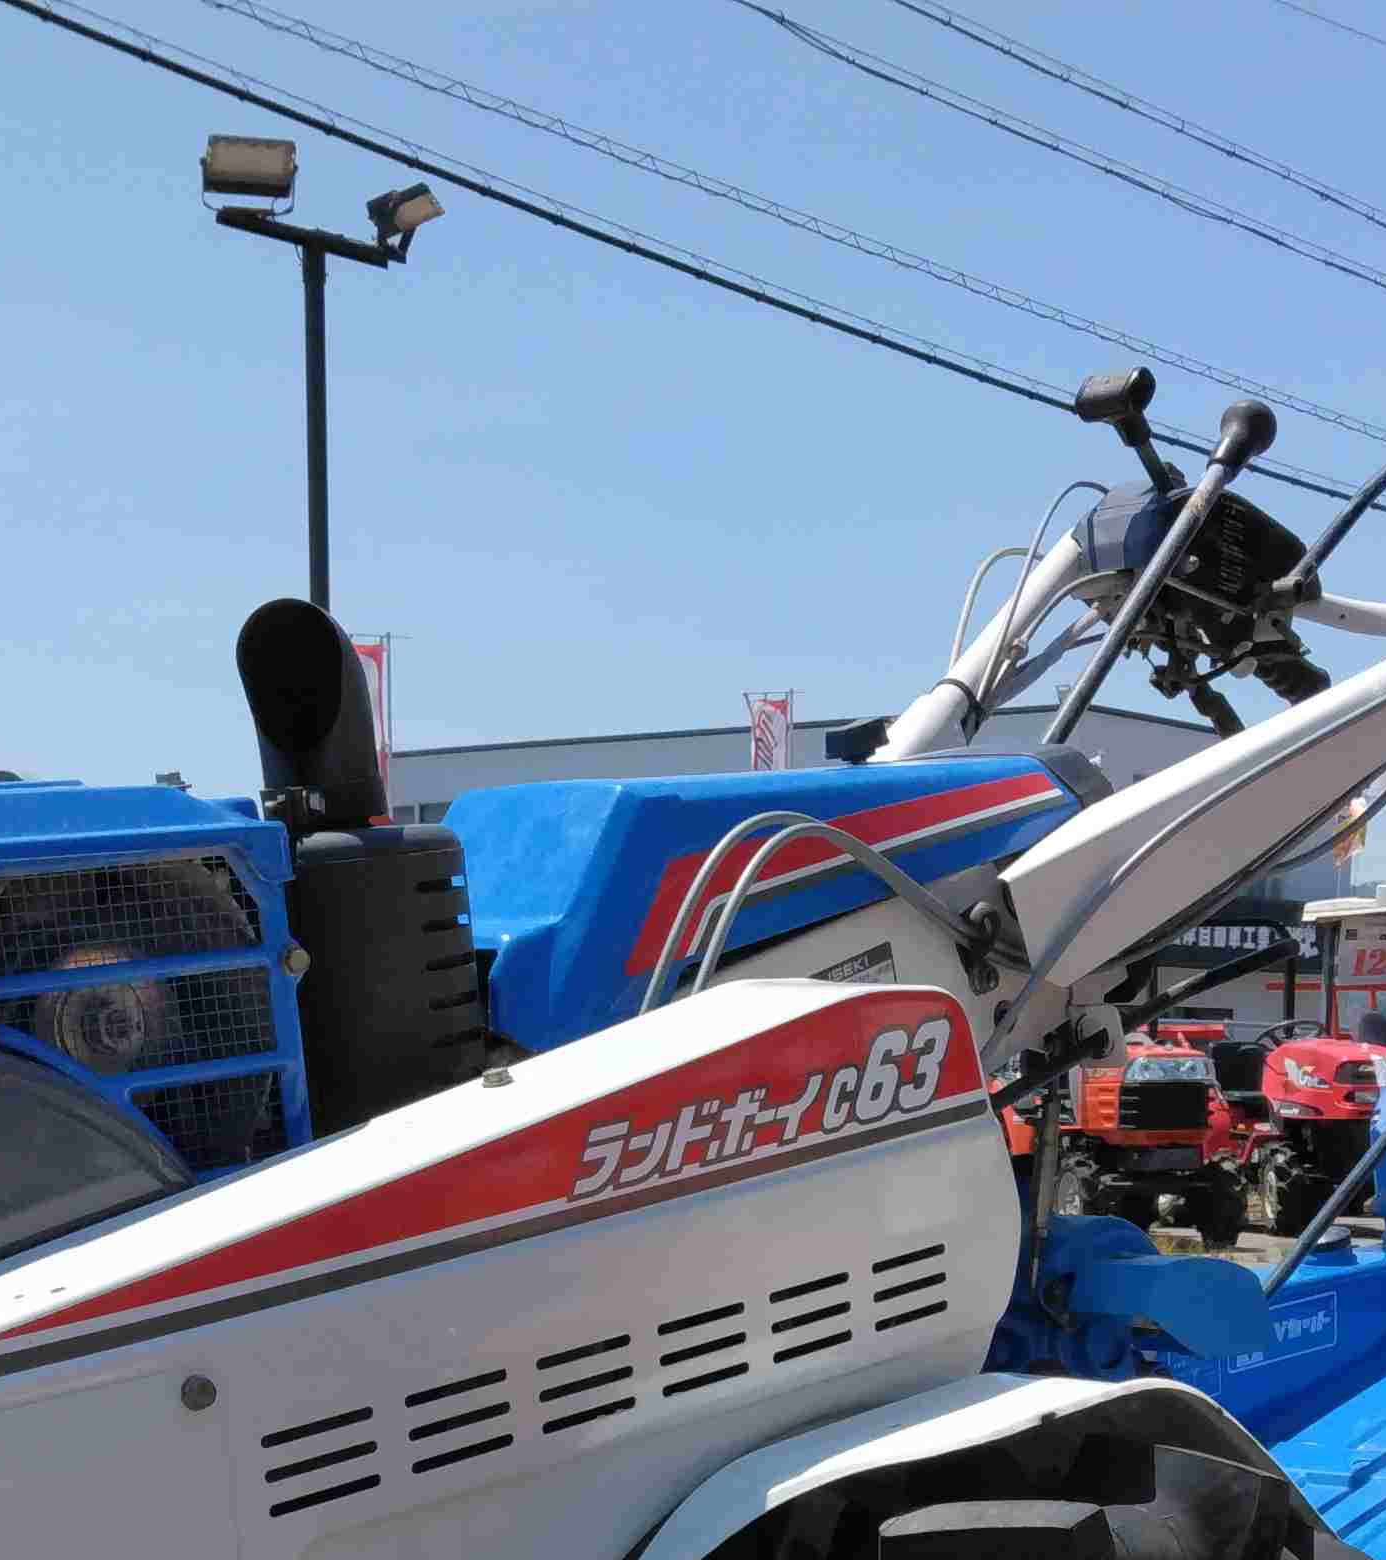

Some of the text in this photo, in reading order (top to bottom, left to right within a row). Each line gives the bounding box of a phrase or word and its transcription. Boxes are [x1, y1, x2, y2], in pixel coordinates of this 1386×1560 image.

[826, 954, 870, 981] ISEKI
[570, 1071, 826, 1198] ランドボーイ
